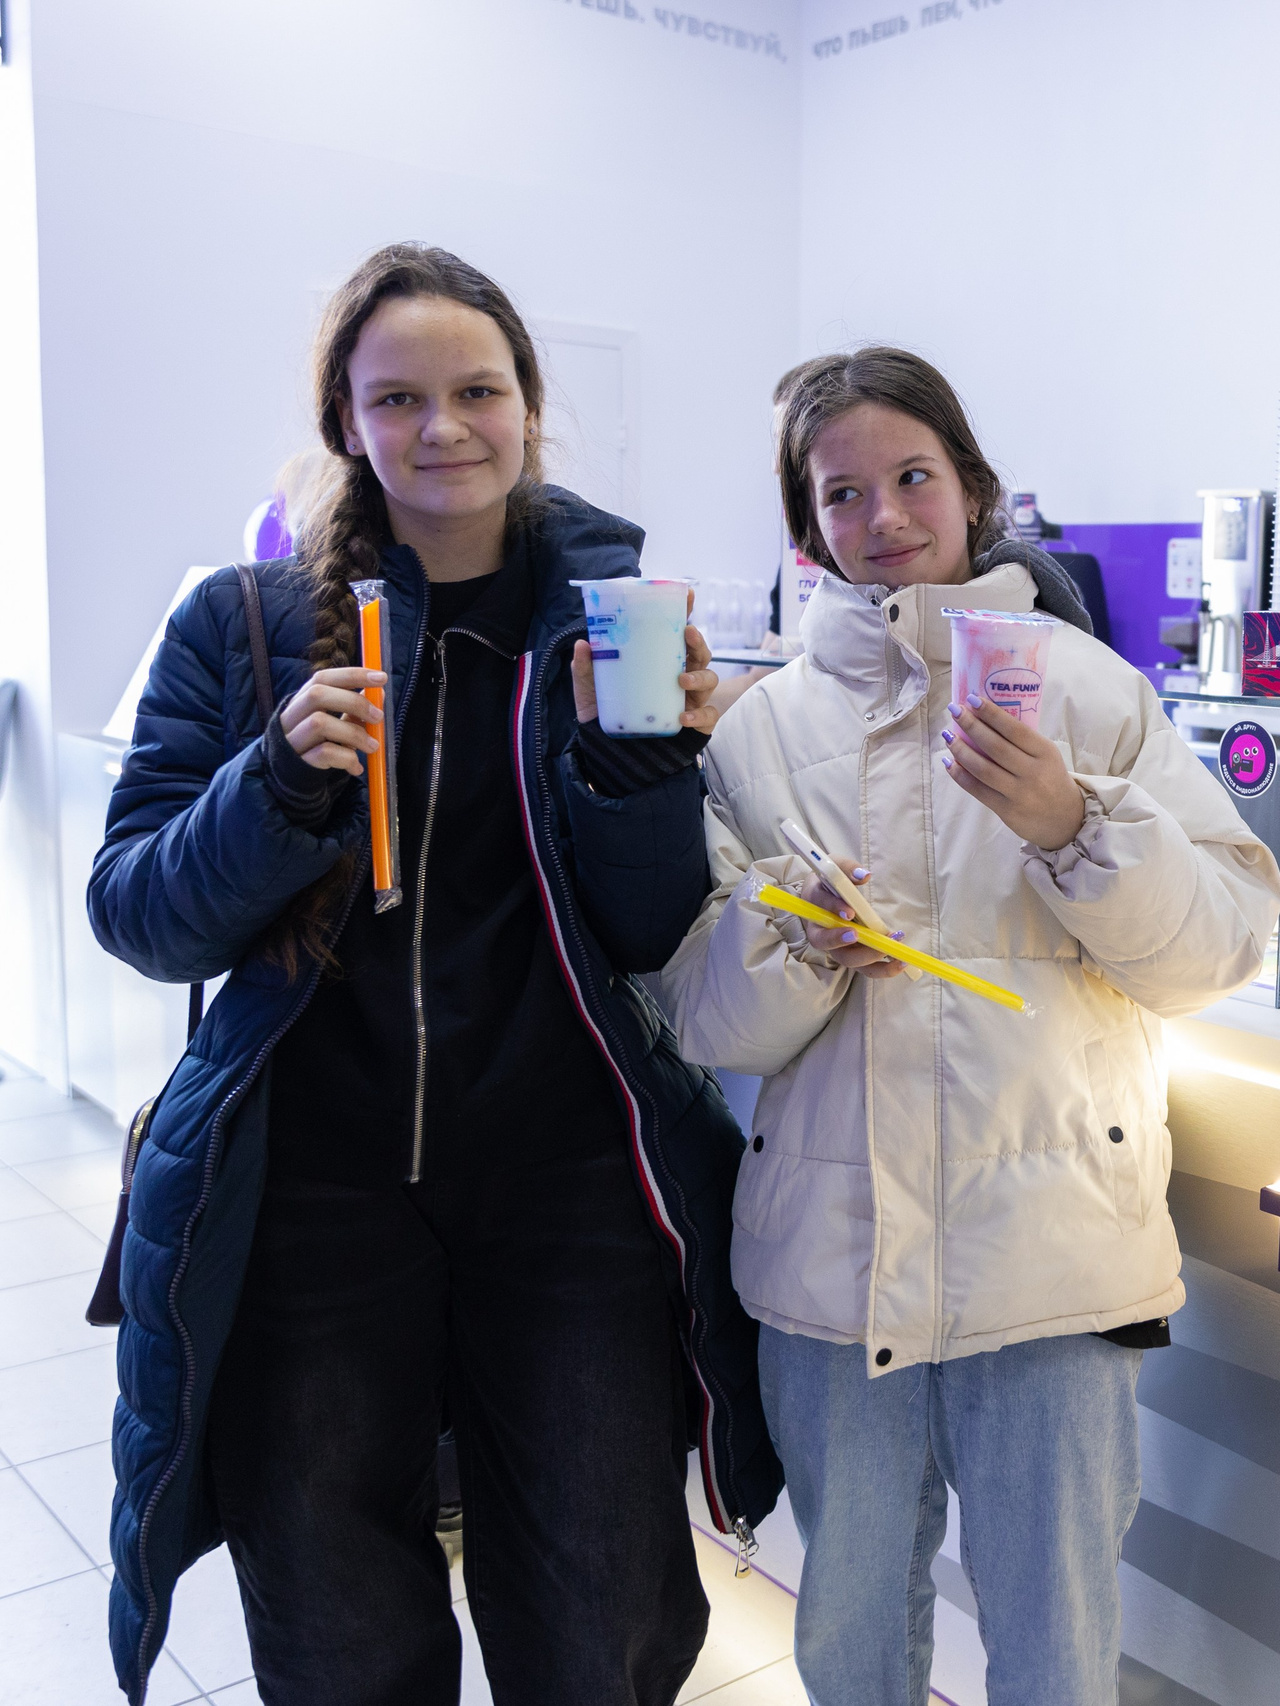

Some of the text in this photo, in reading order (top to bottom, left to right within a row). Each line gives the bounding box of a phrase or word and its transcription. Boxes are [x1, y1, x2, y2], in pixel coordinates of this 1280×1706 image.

[813, 36, 844, 60] ЧТО
[990, 682, 1040, 692] TEA FUNNY
[1235, 762, 1275, 794] ВИДЕОНАБЛЮДЕНИЕ
